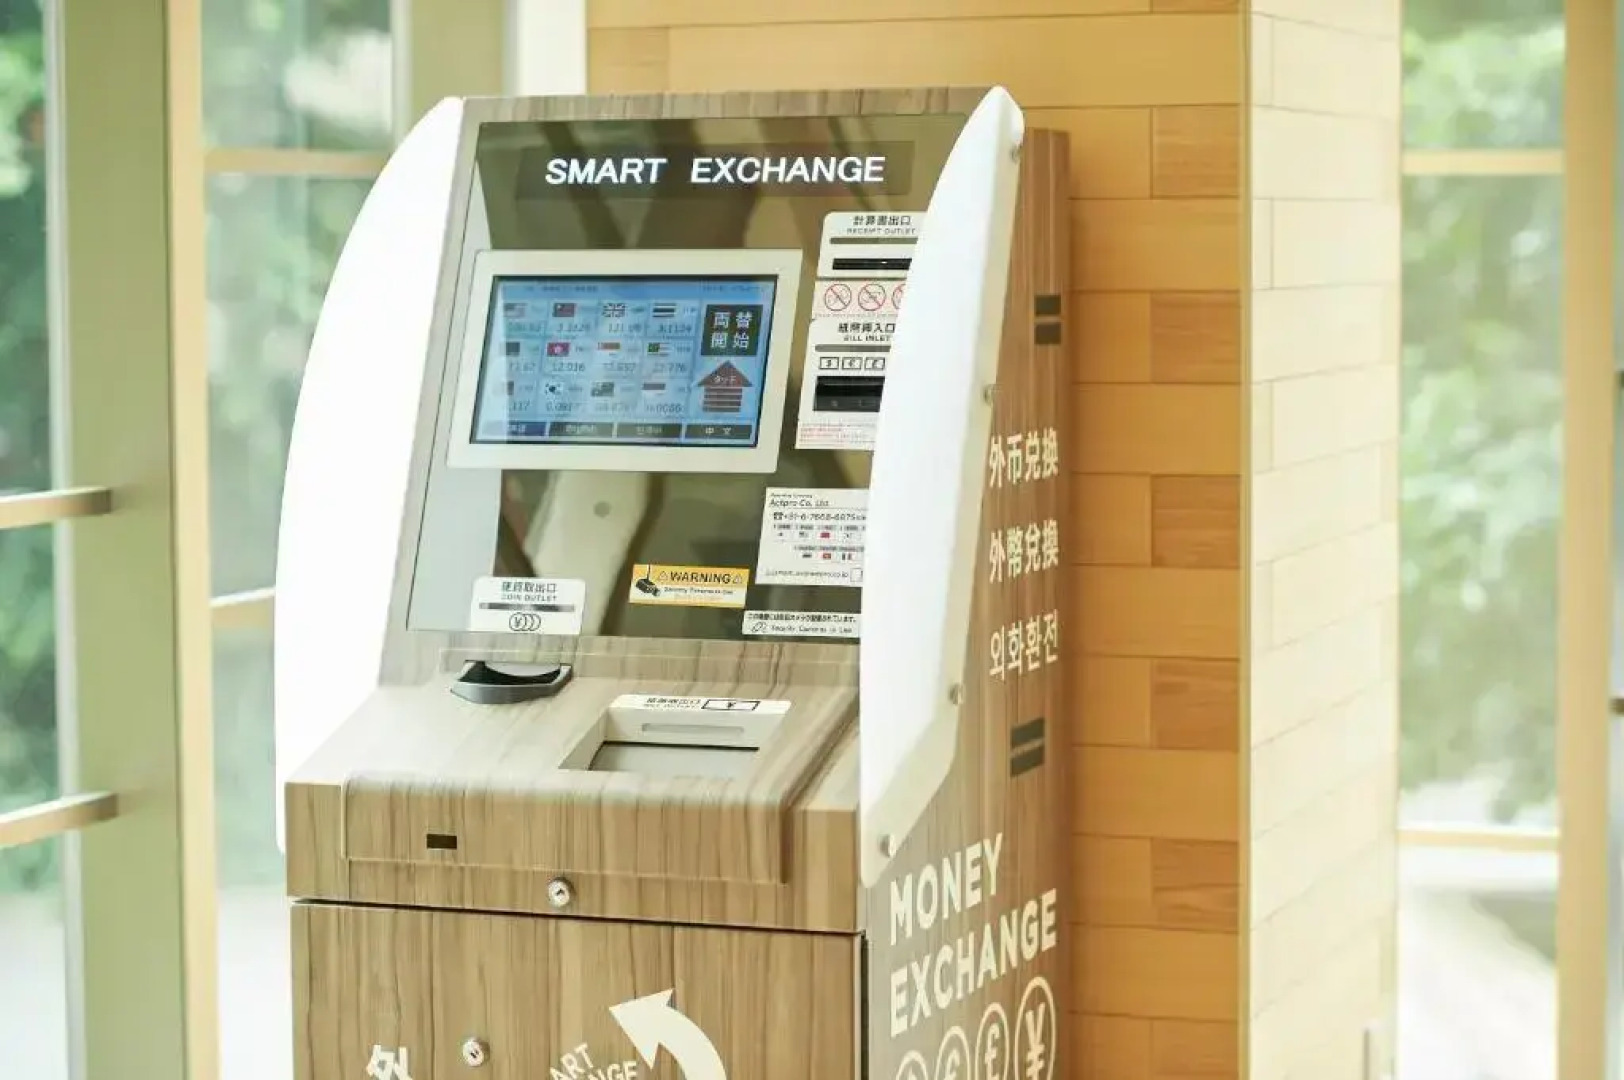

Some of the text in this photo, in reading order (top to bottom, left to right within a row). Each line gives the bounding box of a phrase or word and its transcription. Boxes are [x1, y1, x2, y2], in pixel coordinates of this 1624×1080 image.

[545, 157, 886, 184] SMART EXCHANGE
[670, 571, 731, 584] WARNING
[989, 609, 1059, 681] 외화환전
[890, 832, 1003, 946] MONEY
[890, 888, 1057, 1038] EXCHANGE
